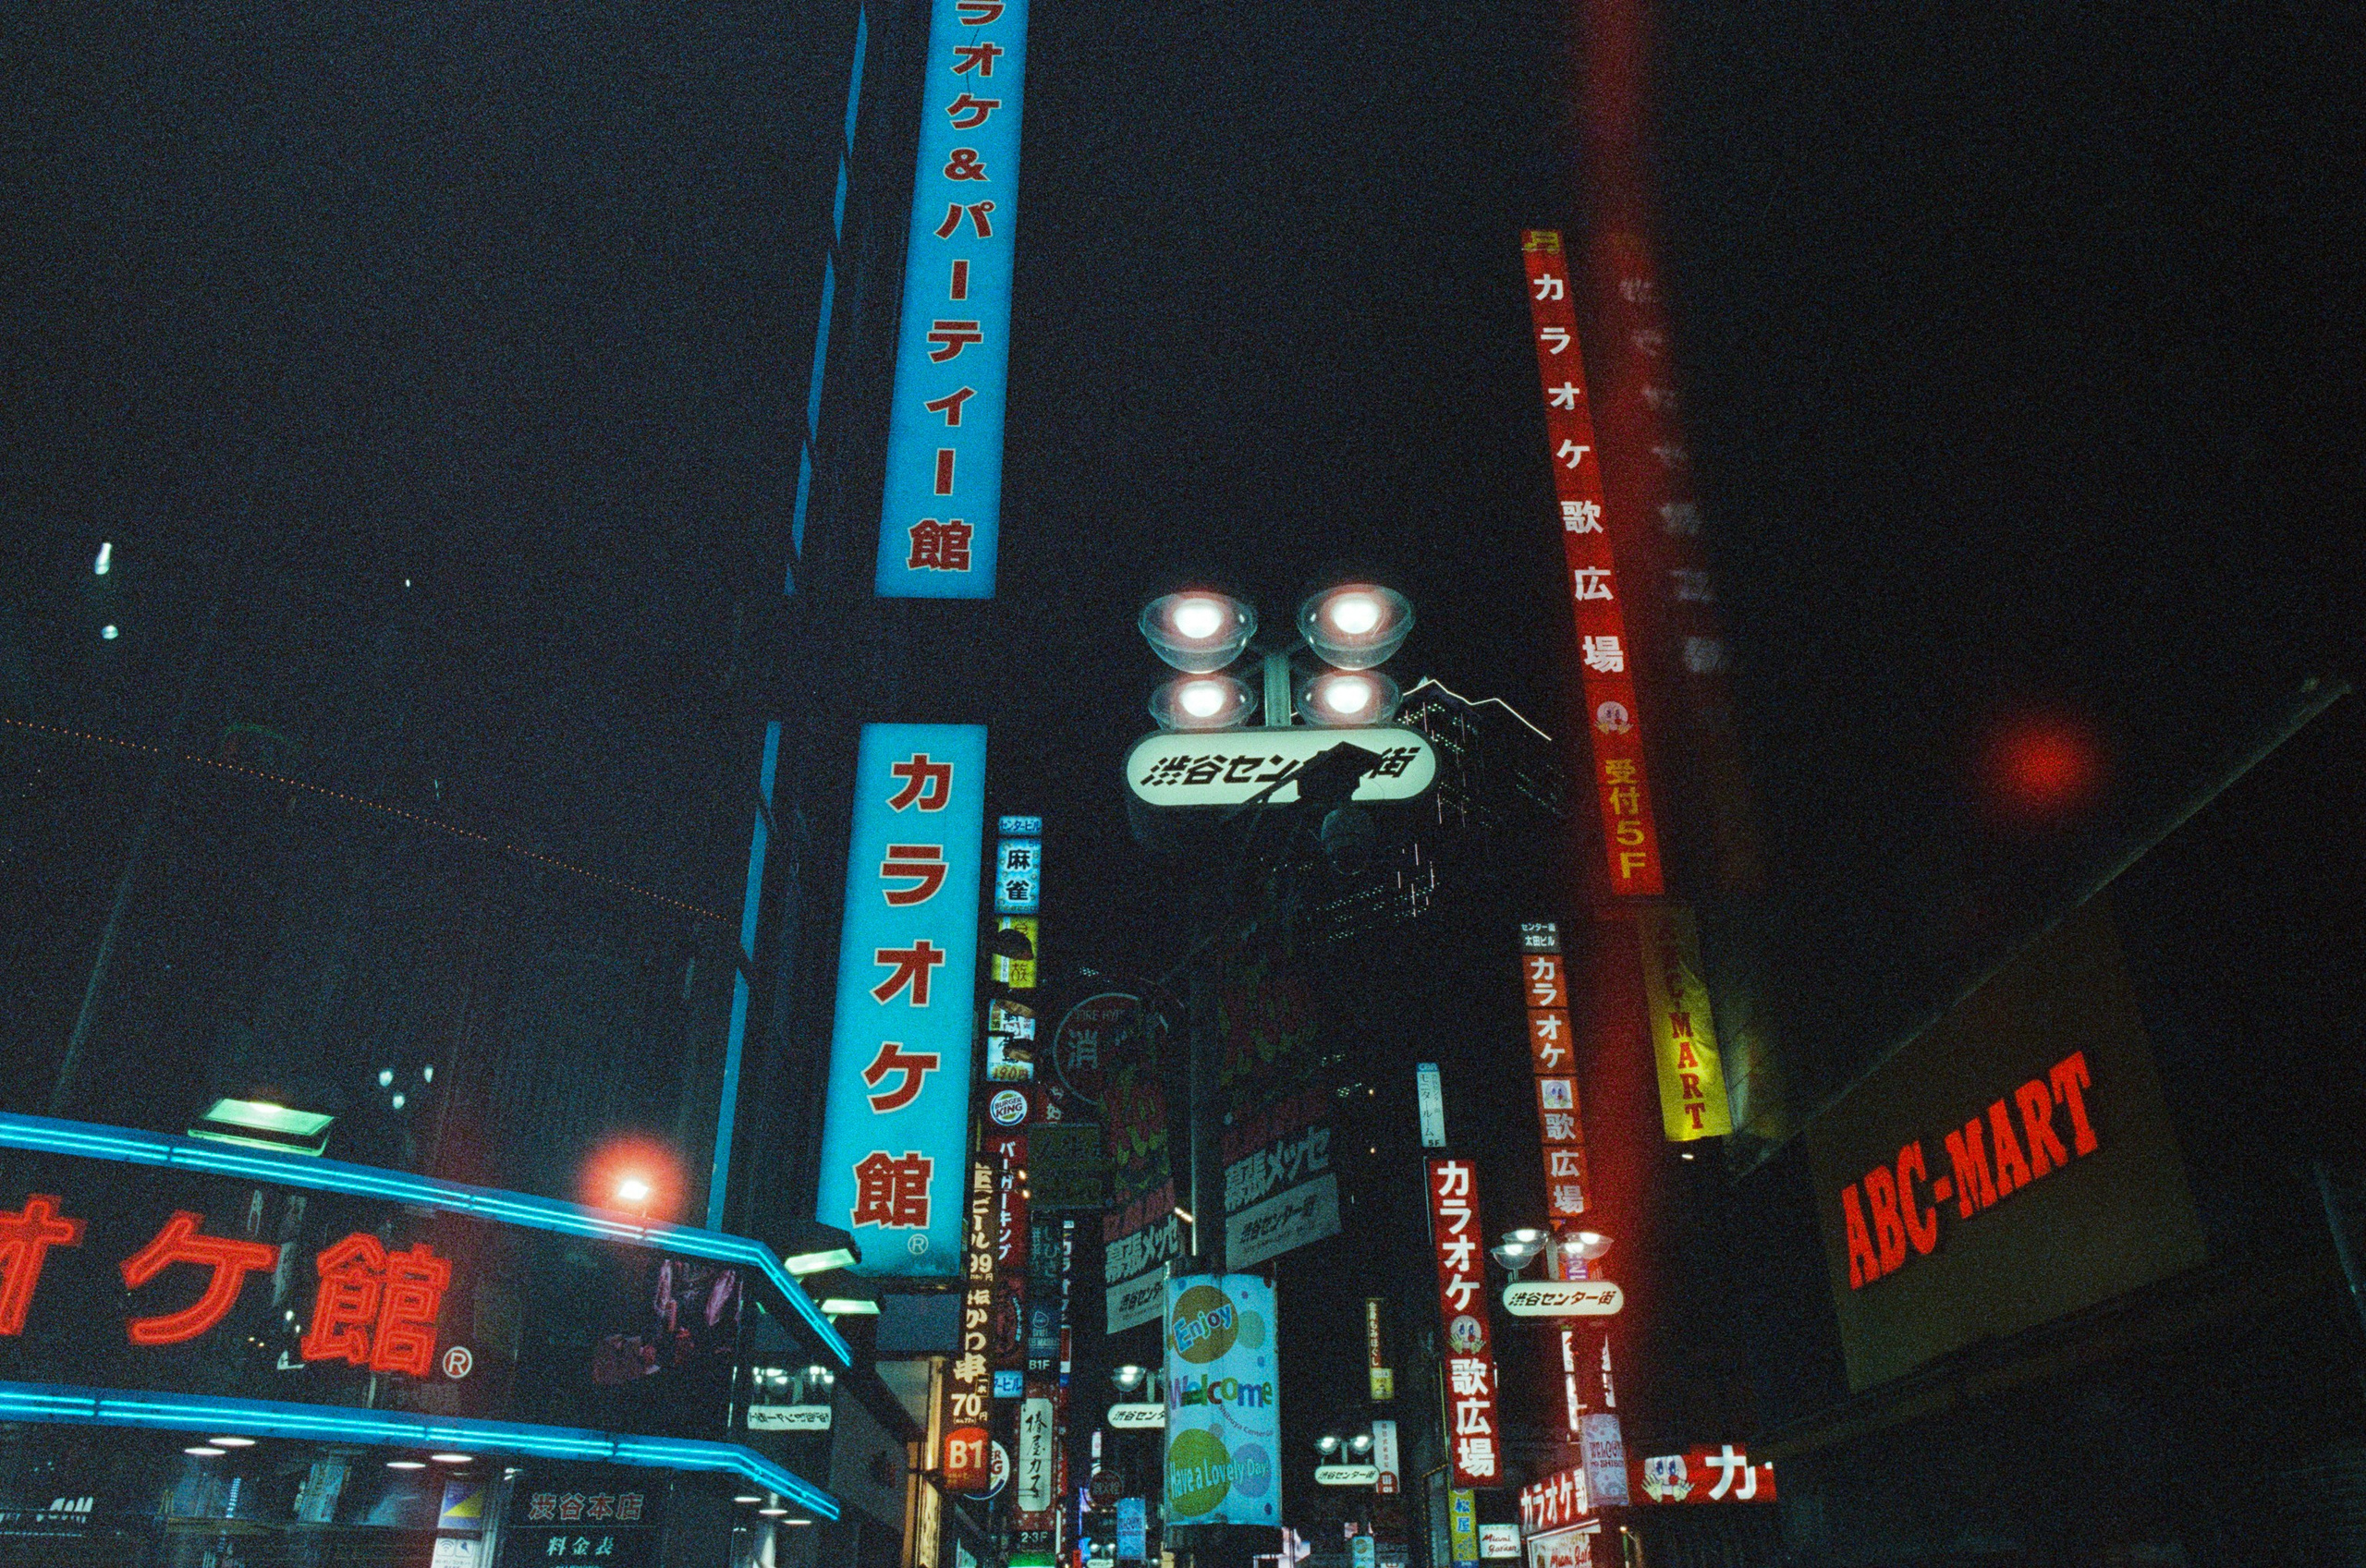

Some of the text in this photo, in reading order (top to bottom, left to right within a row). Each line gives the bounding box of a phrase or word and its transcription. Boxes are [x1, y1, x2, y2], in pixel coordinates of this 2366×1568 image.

[1533, 273, 1624, 673] カラオケ歌広場
[1140, 746, 1421, 787] 渋谷セン街
[999, 819, 1041, 831] センタービル
[1605, 759, 1646, 879] 受付5F
[1006, 848, 1031, 902] 麻雀
[1525, 935, 1555, 946] 太田ビル
[850, 753, 955, 1231] カラオケ館
[1531, 956, 1584, 1214] カラオケ 歌広場
[994, 1096, 1022, 1110] BURGER
[995, 1102, 1023, 1118] KING
[1842, 1051, 2098, 1291] ABC-MART
[998, 1141, 1017, 1261] バーガーキング
[1508, 1290, 1616, 1307] 渋谷センター街
[1173, 1304, 1232, 1353] Enjoy
[1437, 1161, 1495, 1478] カラオケ 歌広場
[1029, 1359, 1050, 1370] B1F
[1170, 1374, 1273, 1410] Welcome
[1218, 1404, 1243, 1430] Shibuya
[949, 1440, 983, 1468] B1
[1169, 1461, 1194, 1499] Have
[1195, 1466, 1202, 1489] a
[1203, 1458, 1244, 1487] Lovely
[529, 1491, 644, 1521] 渋谷本店
[1454, 1498, 1471, 1533] 松屋
[547, 1536, 614, 1556] 料金表
[1482, 1534, 1511, 1542] Miami
